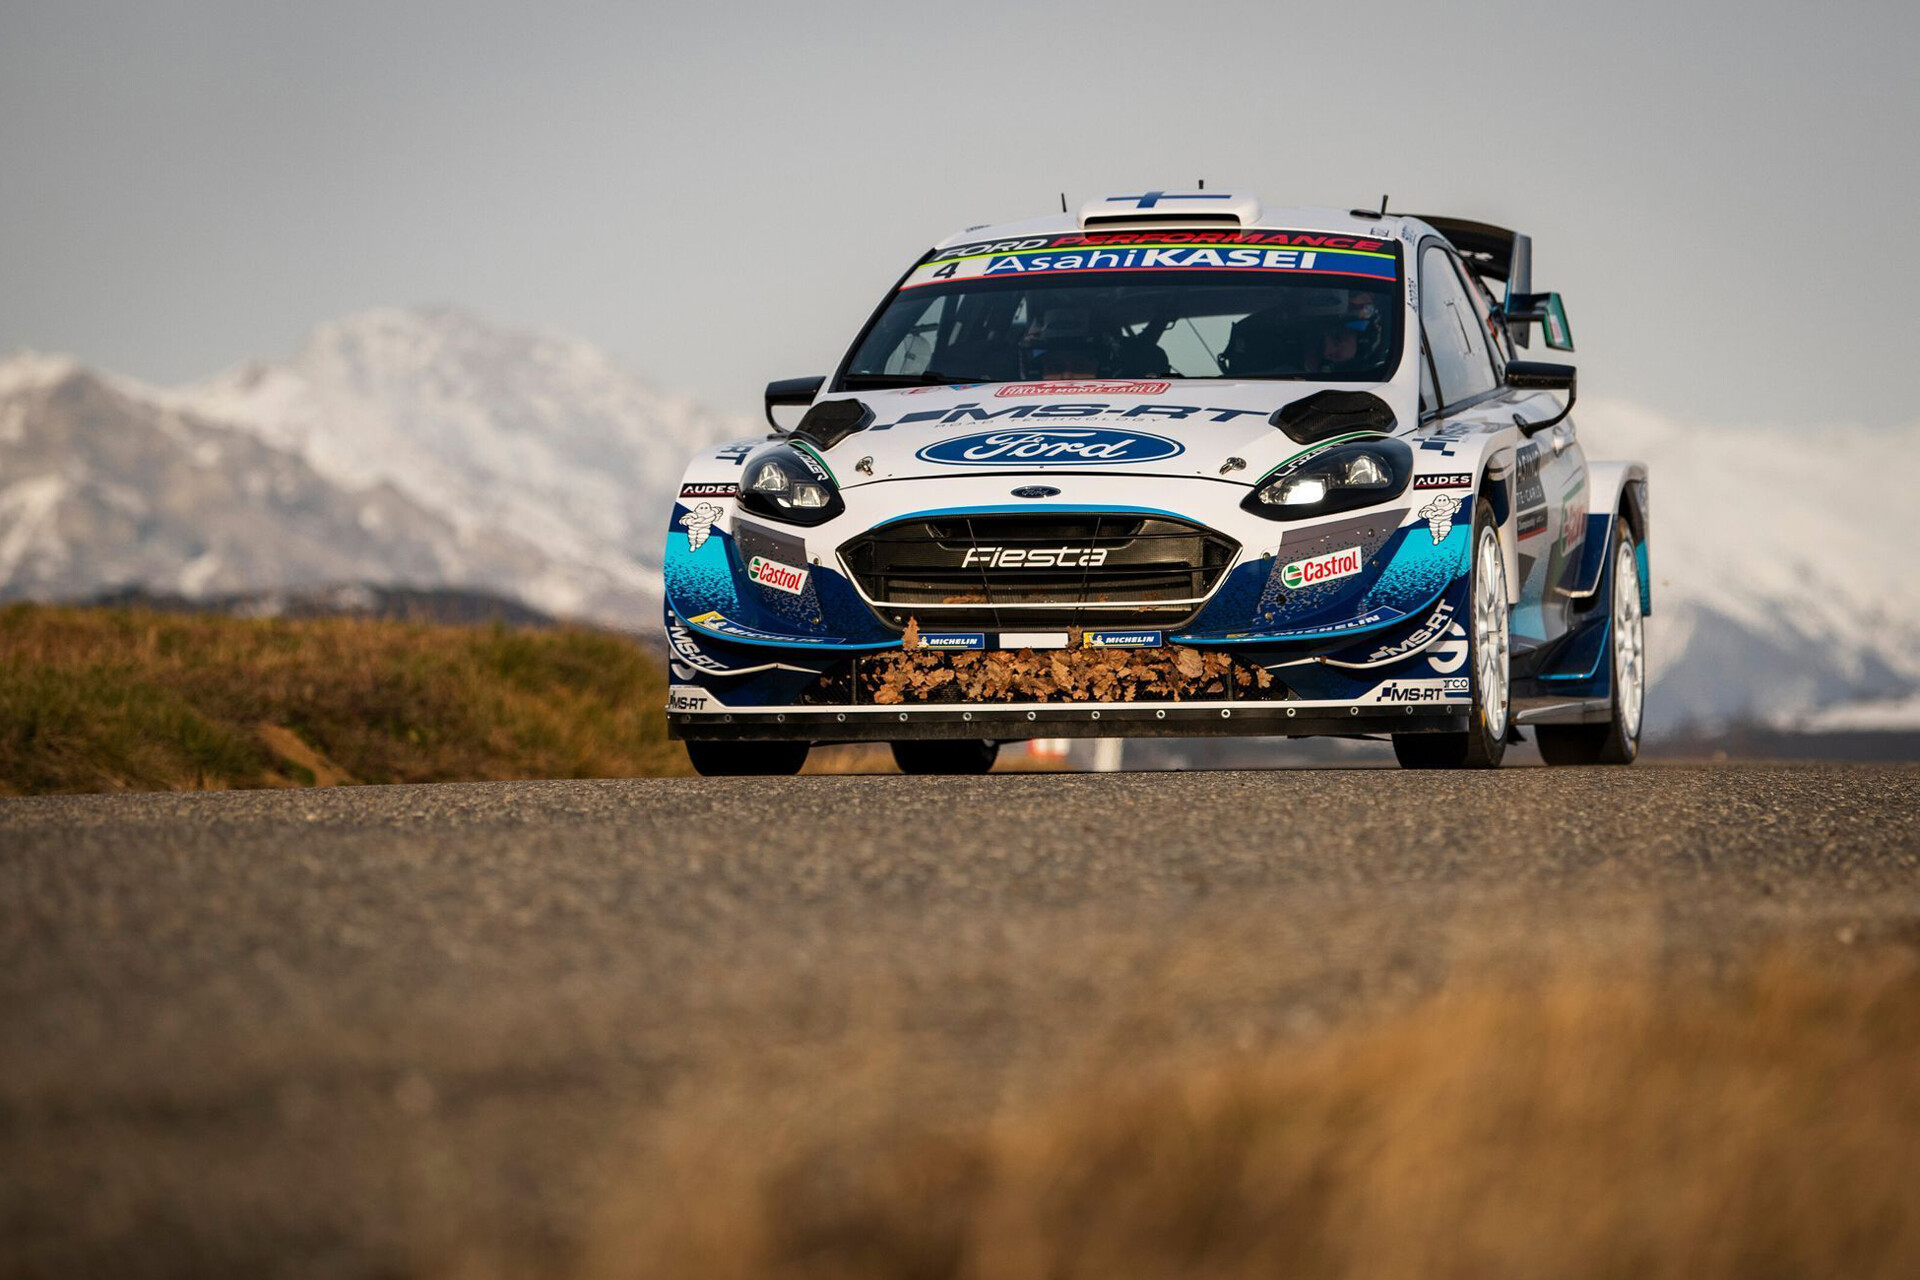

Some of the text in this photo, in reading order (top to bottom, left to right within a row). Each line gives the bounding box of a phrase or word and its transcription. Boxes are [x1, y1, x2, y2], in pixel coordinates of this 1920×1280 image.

[934, 239, 1049, 261] FORD
[1049, 233, 1384, 251] PERFORMANCE
[932, 262, 960, 278] 4
[1004, 385, 1051, 395] RALLYE
[934, 420, 994, 428] ROAD
[963, 431, 1136, 460] Ford
[793, 449, 829, 481] LAZER
[1415, 475, 1470, 486] AUDES
[682, 485, 737, 494] AUDES
[961, 546, 1108, 568] Fiesta
[1304, 551, 1359, 581] Castrol
[759, 562, 802, 590] Castrol
[929, 637, 978, 646] MICHELIN
[1105, 635, 1156, 645] MICHELIN
